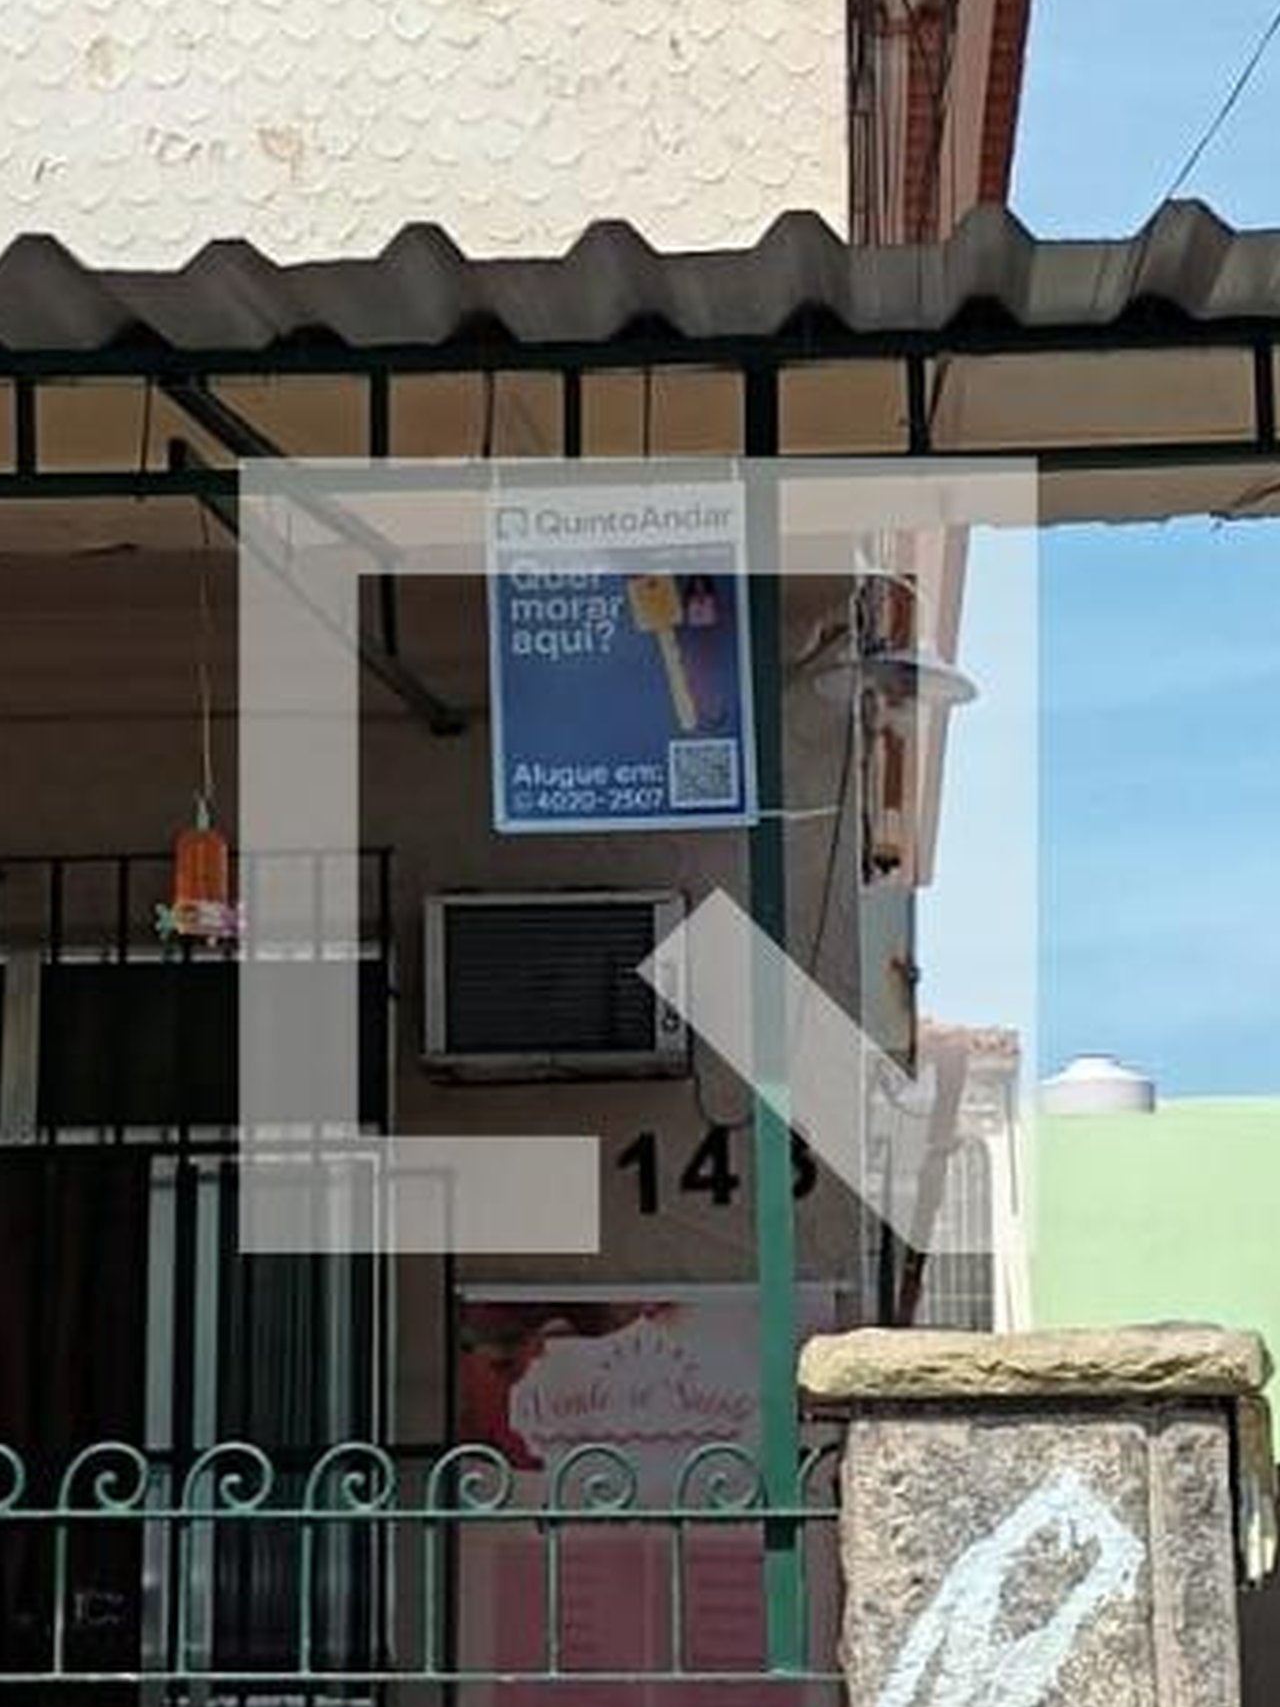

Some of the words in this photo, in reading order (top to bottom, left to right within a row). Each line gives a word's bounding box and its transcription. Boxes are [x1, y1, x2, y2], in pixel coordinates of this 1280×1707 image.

[535, 502, 733, 538] QuintoAndar
[511, 595, 623, 622] morar
[512, 620, 617, 661] aqui?
[513, 762, 609, 788] Alugue
